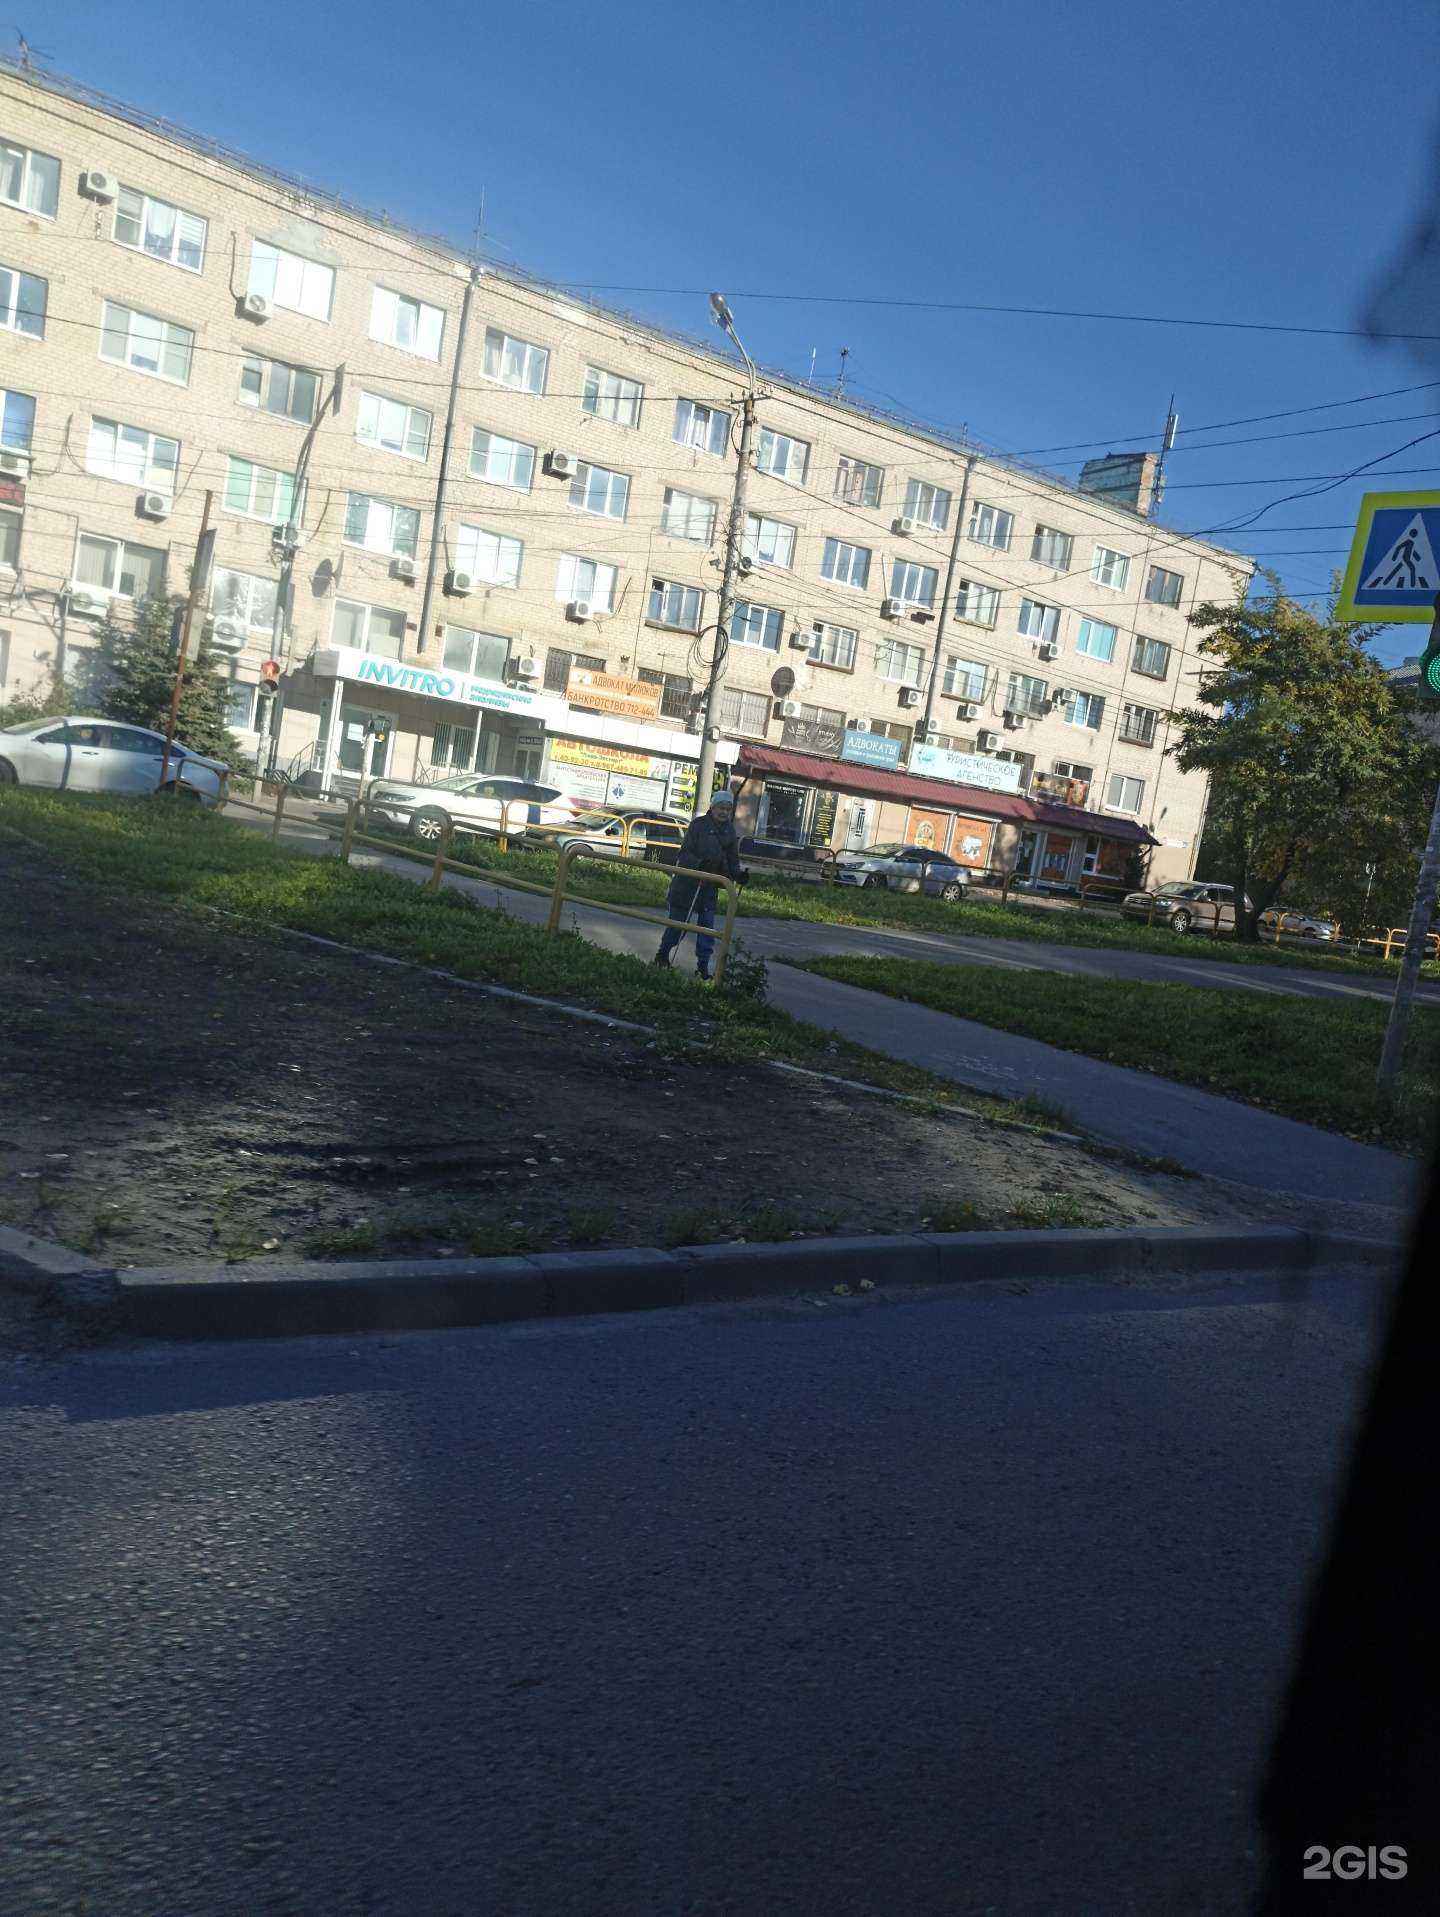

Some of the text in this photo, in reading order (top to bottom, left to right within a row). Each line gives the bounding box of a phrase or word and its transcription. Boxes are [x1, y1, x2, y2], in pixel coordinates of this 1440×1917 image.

[358, 659, 455, 696] INVITRO
[592, 674, 624, 689] АДВОКАТ
[567, 691, 656, 717] БАНКРОТСТВО 712-444
[847, 737, 898, 756] АДВОКАТЫ
[674, 762, 697, 776] РЕМ
[945, 751, 1016, 776] ТУРИСТИЧЕСКОЕ
[956, 769, 1002, 785] АГЕНСТВО
